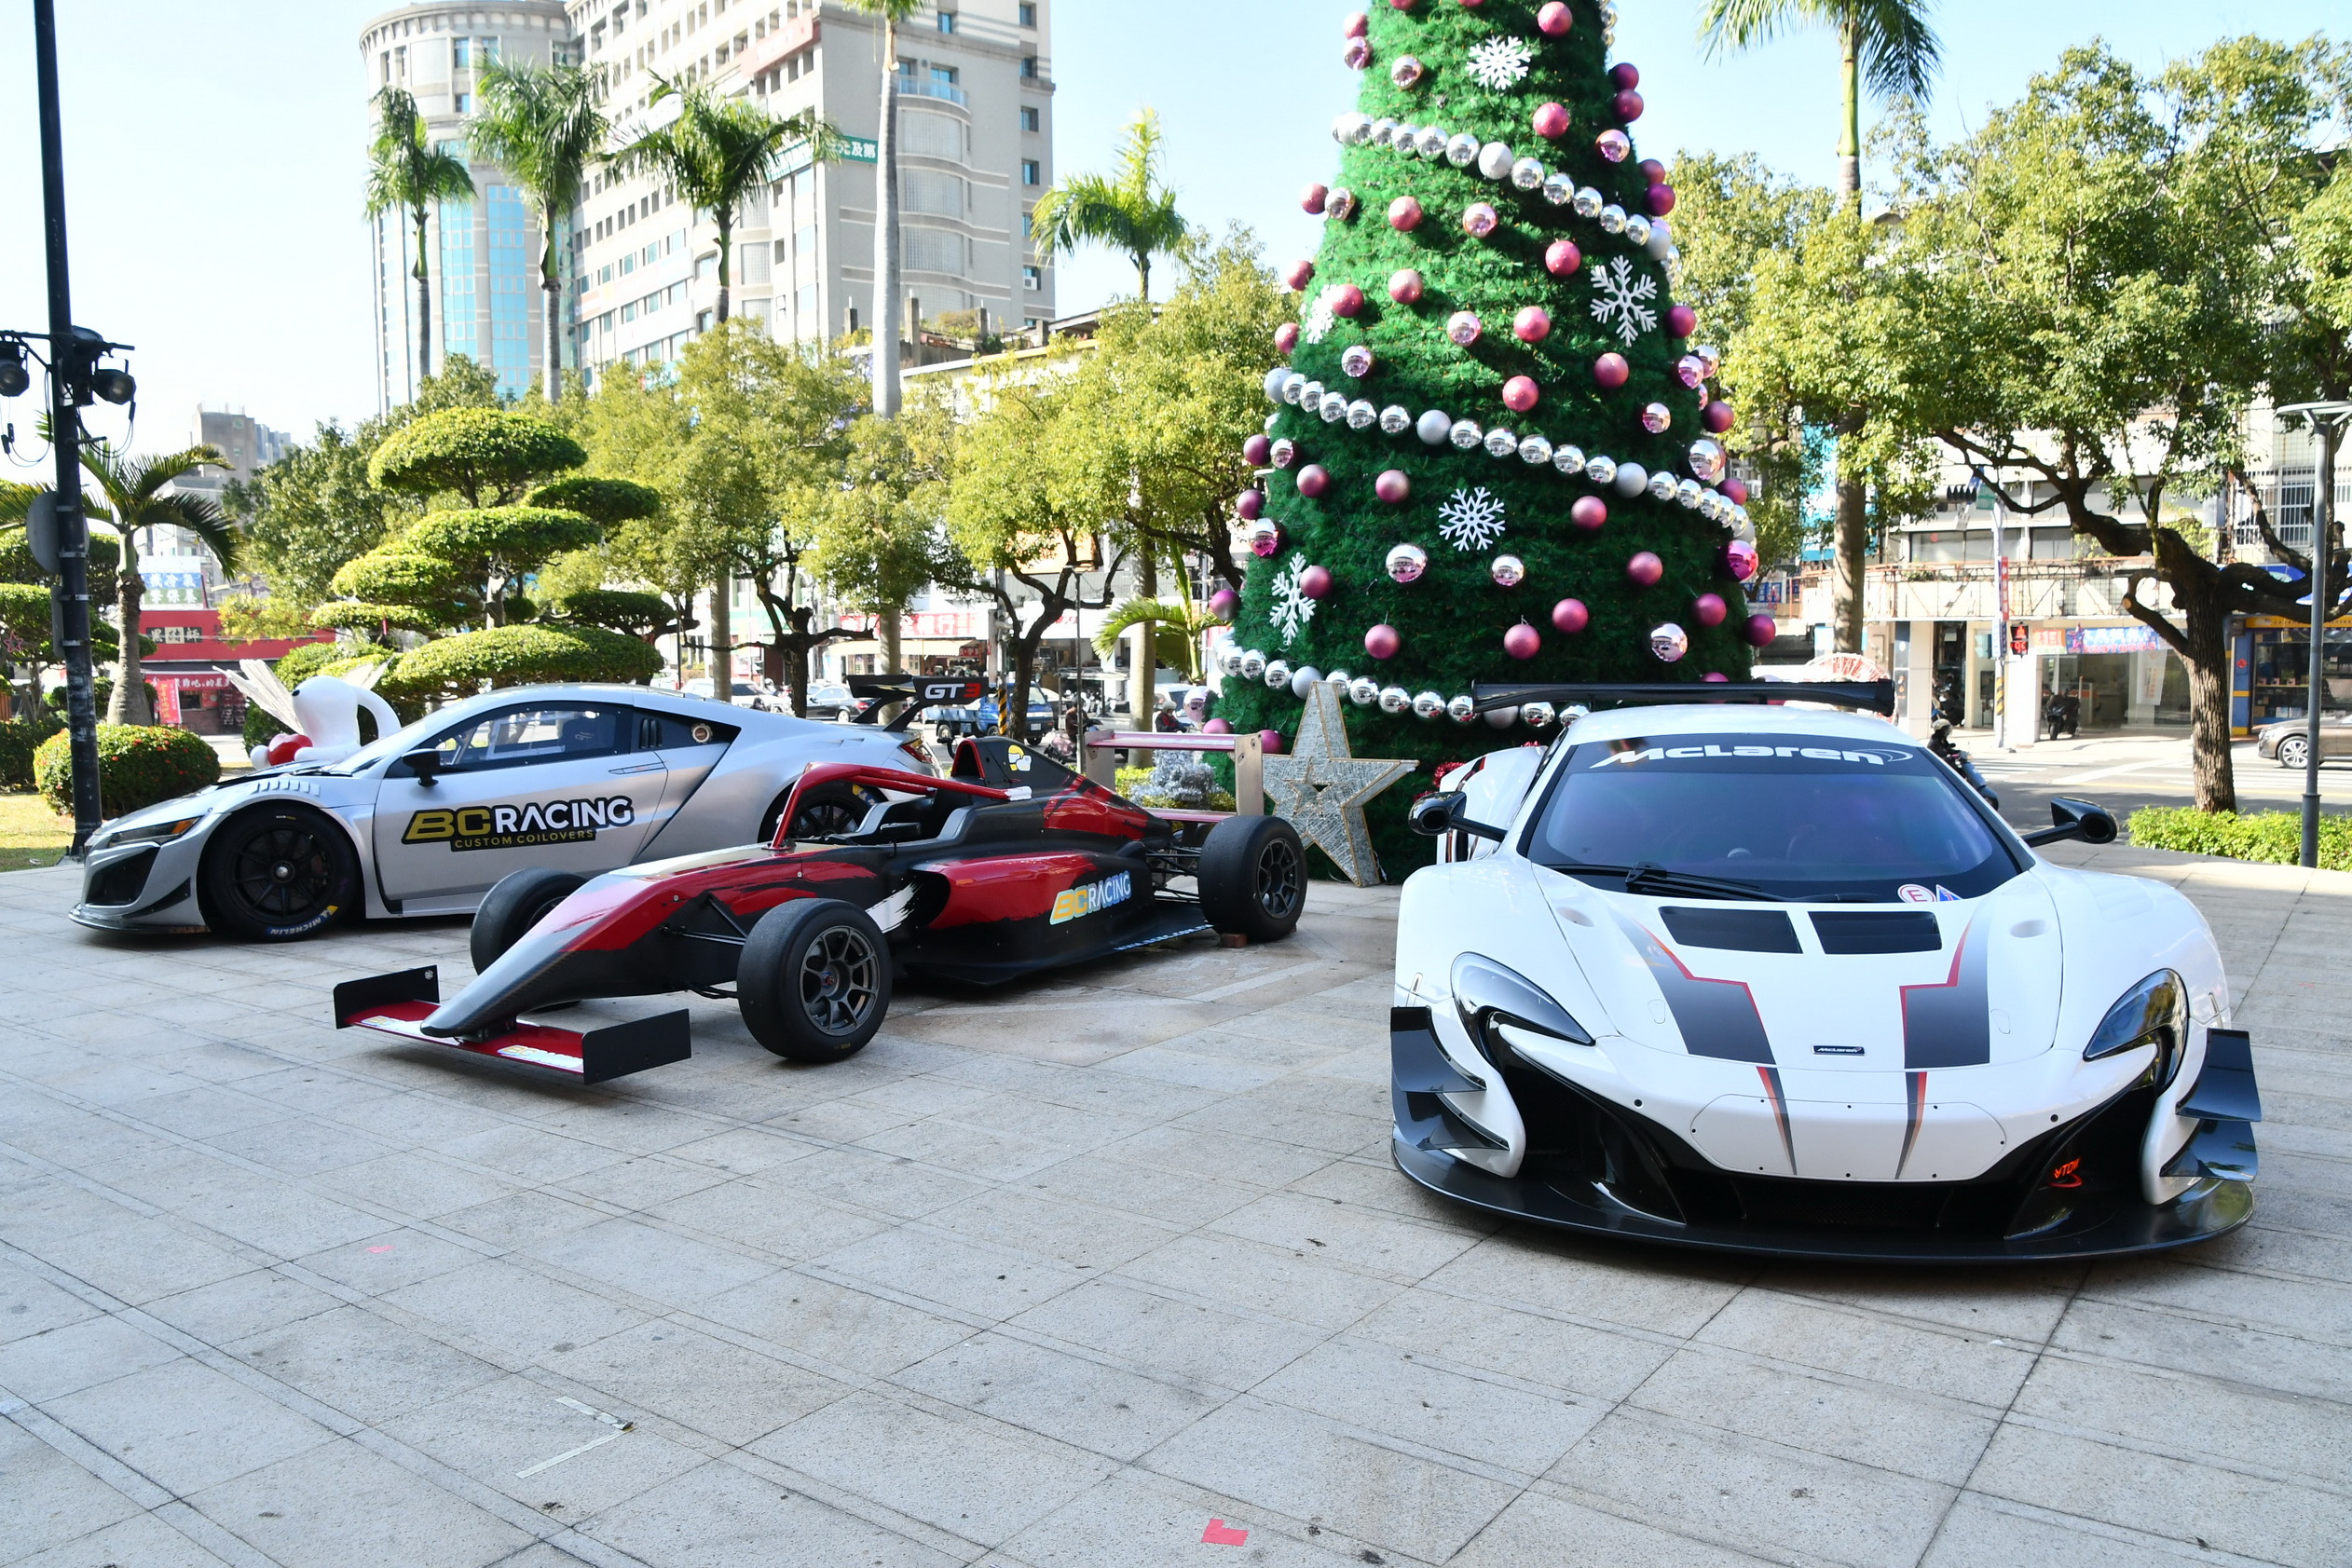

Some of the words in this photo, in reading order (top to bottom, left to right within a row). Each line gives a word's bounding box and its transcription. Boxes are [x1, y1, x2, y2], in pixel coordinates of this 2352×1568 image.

[924, 682, 982, 700] GT3
[1588, 744, 1885, 770] McLaren
[454, 835, 513, 850] CUSTOM
[515, 828, 595, 845] COILOVERS
[1906, 889, 1928, 903] E
[269, 916, 322, 935] MICHELIN
